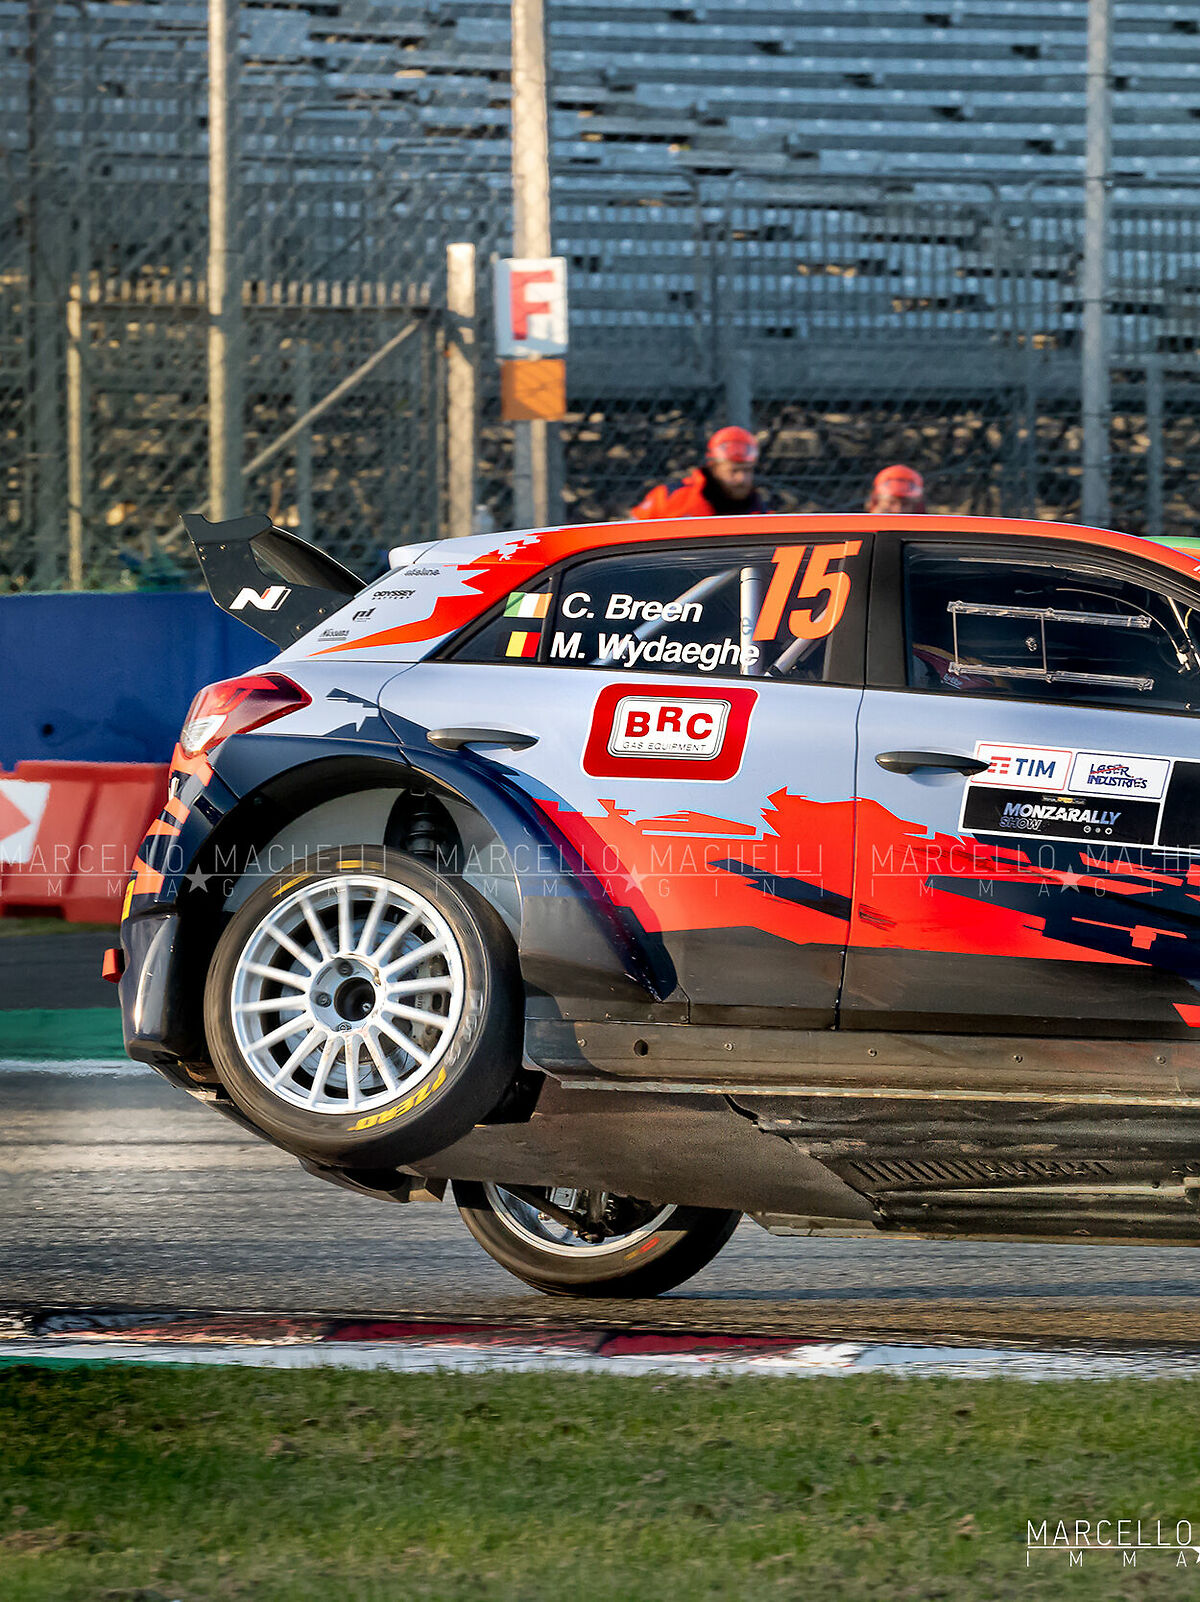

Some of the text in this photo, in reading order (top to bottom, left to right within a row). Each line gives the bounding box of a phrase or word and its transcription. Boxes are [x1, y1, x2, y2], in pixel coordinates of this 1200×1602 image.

[511, 270, 555, 340] F
[752, 540, 863, 642] 15
[562, 592, 703, 623] C. Breen
[550, 632, 761, 671] M. Wydaeghe
[624, 706, 714, 740] BRC
[622, 741, 707, 752] GAS EQUIPMENT
[1015, 757, 1057, 779] TIM
[1087, 774, 1148, 789] INDUSTRIES
[999, 816, 1042, 832] SHOW
